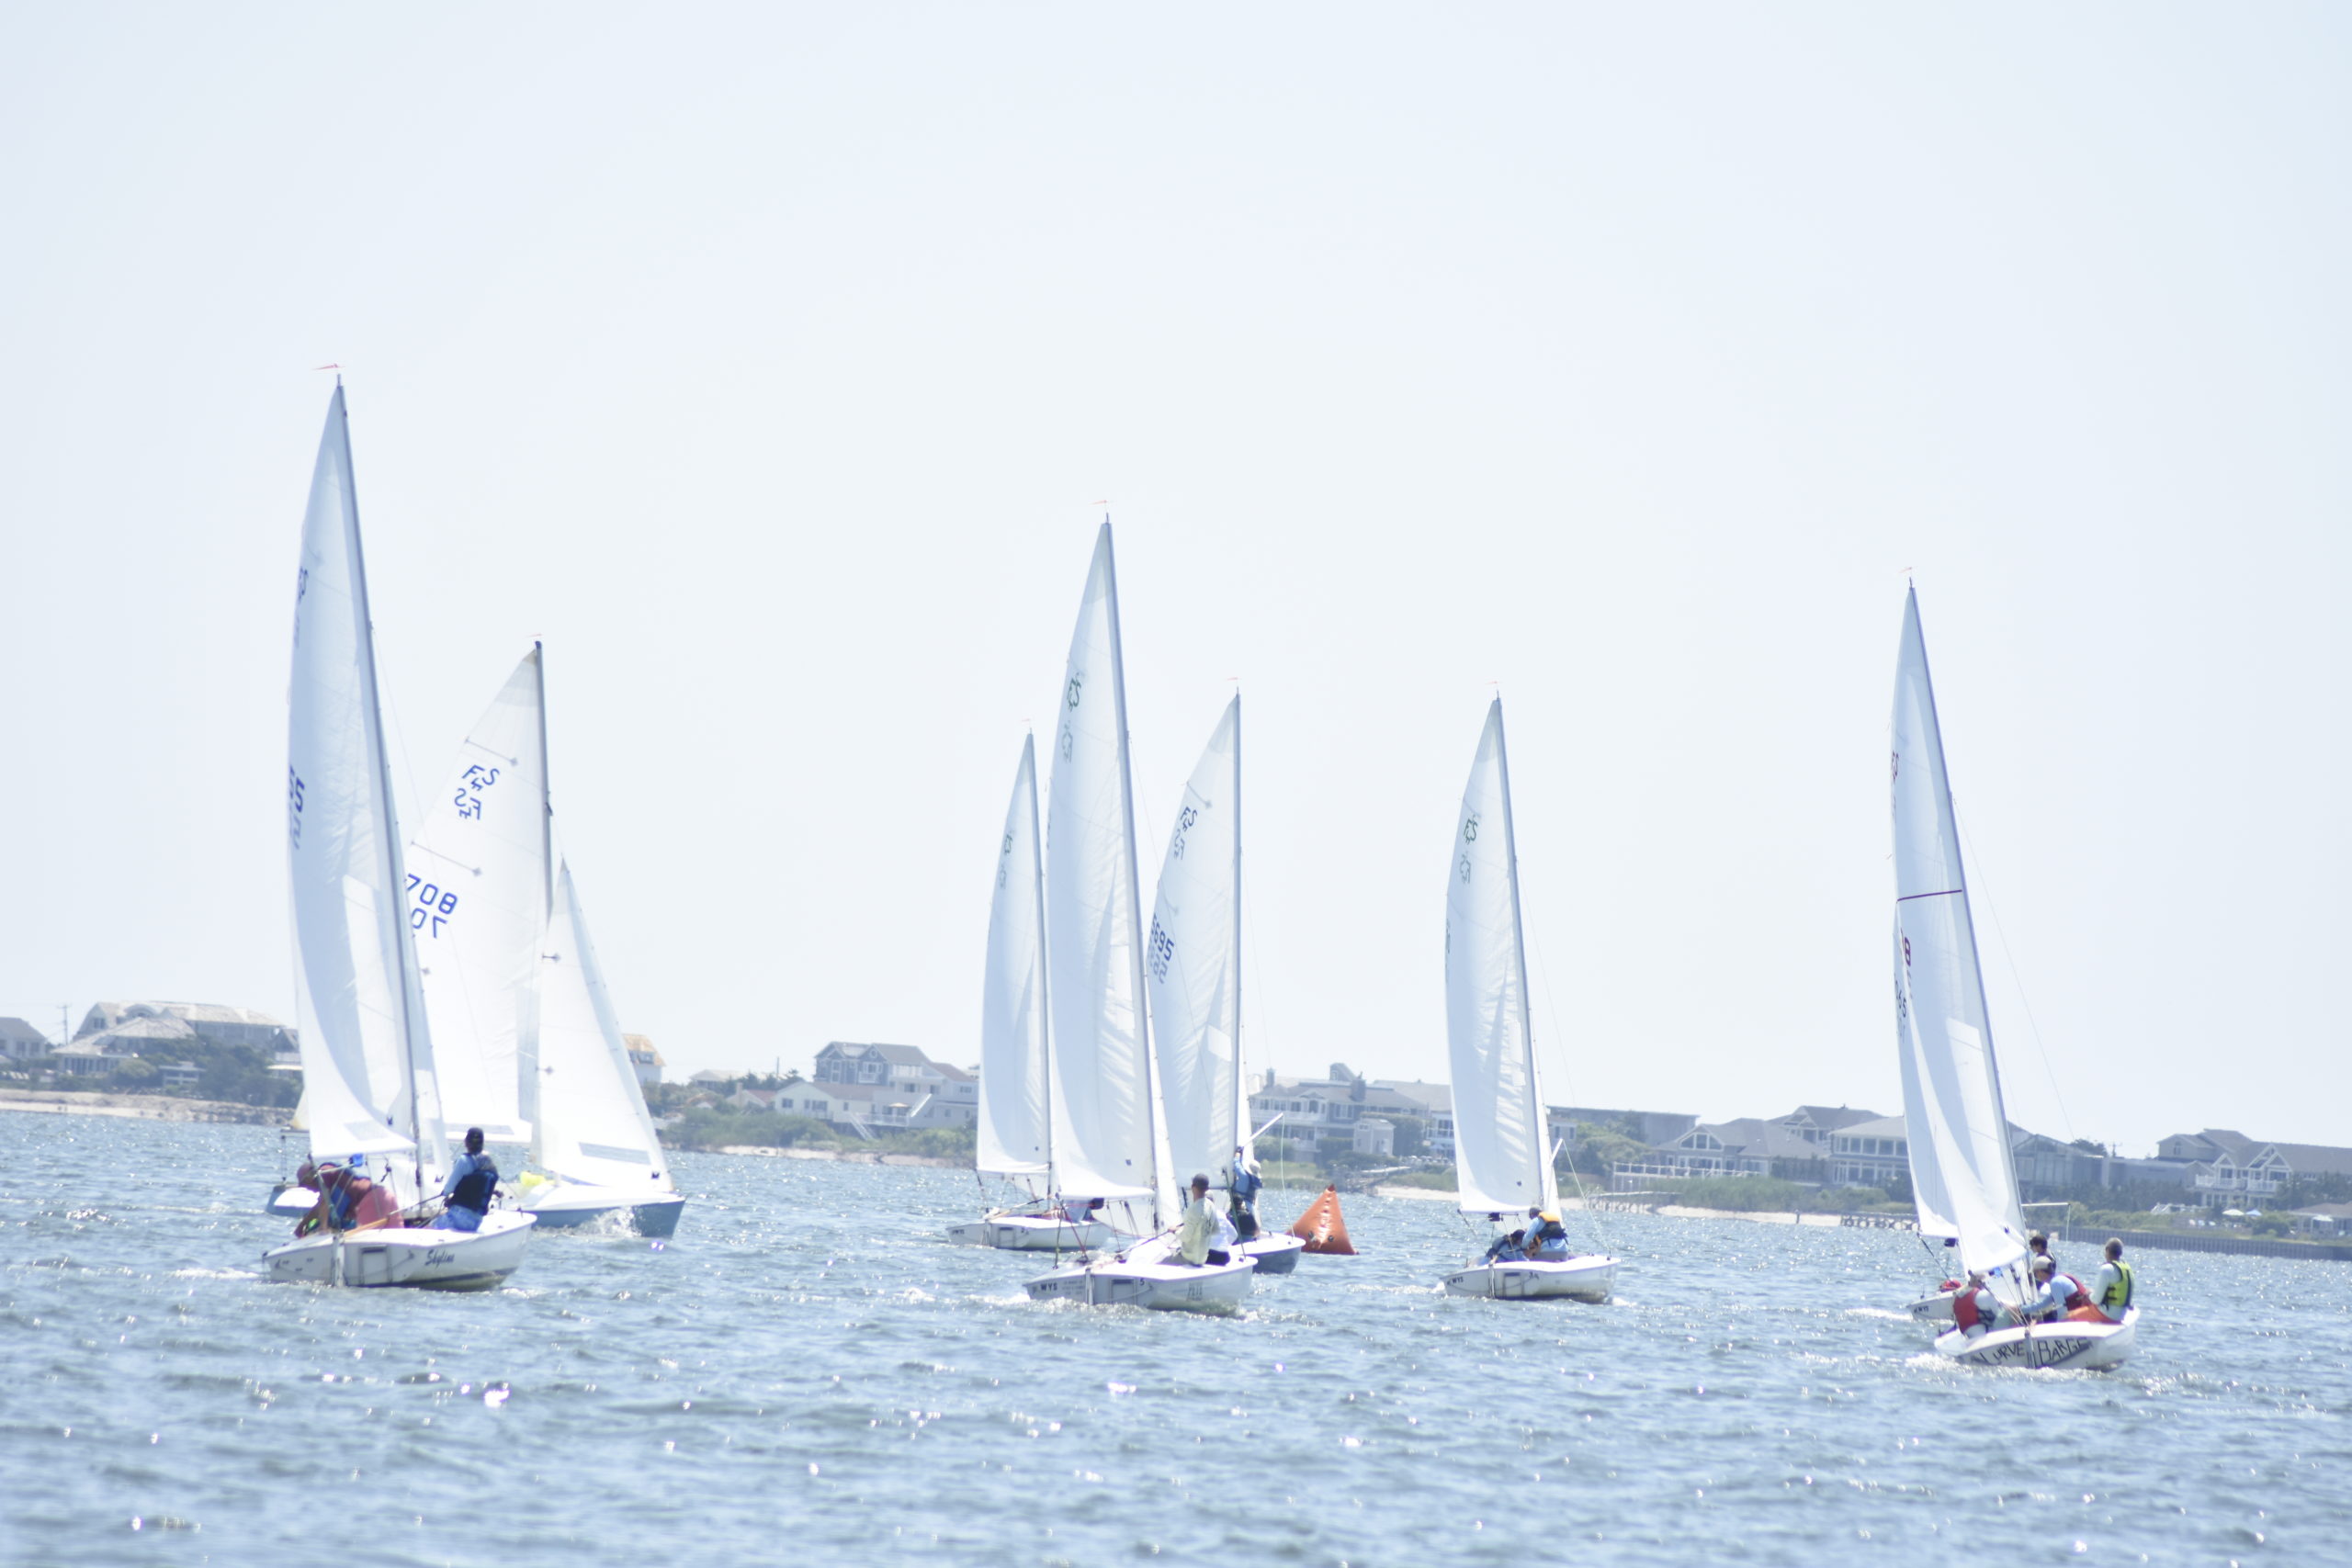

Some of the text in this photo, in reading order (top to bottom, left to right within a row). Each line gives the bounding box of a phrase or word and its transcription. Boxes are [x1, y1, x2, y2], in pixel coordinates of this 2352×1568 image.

[406, 873, 458, 915] 708
[424, 1248, 456, 1270] Skyline
[1040, 1282, 1058, 1292] WYS
